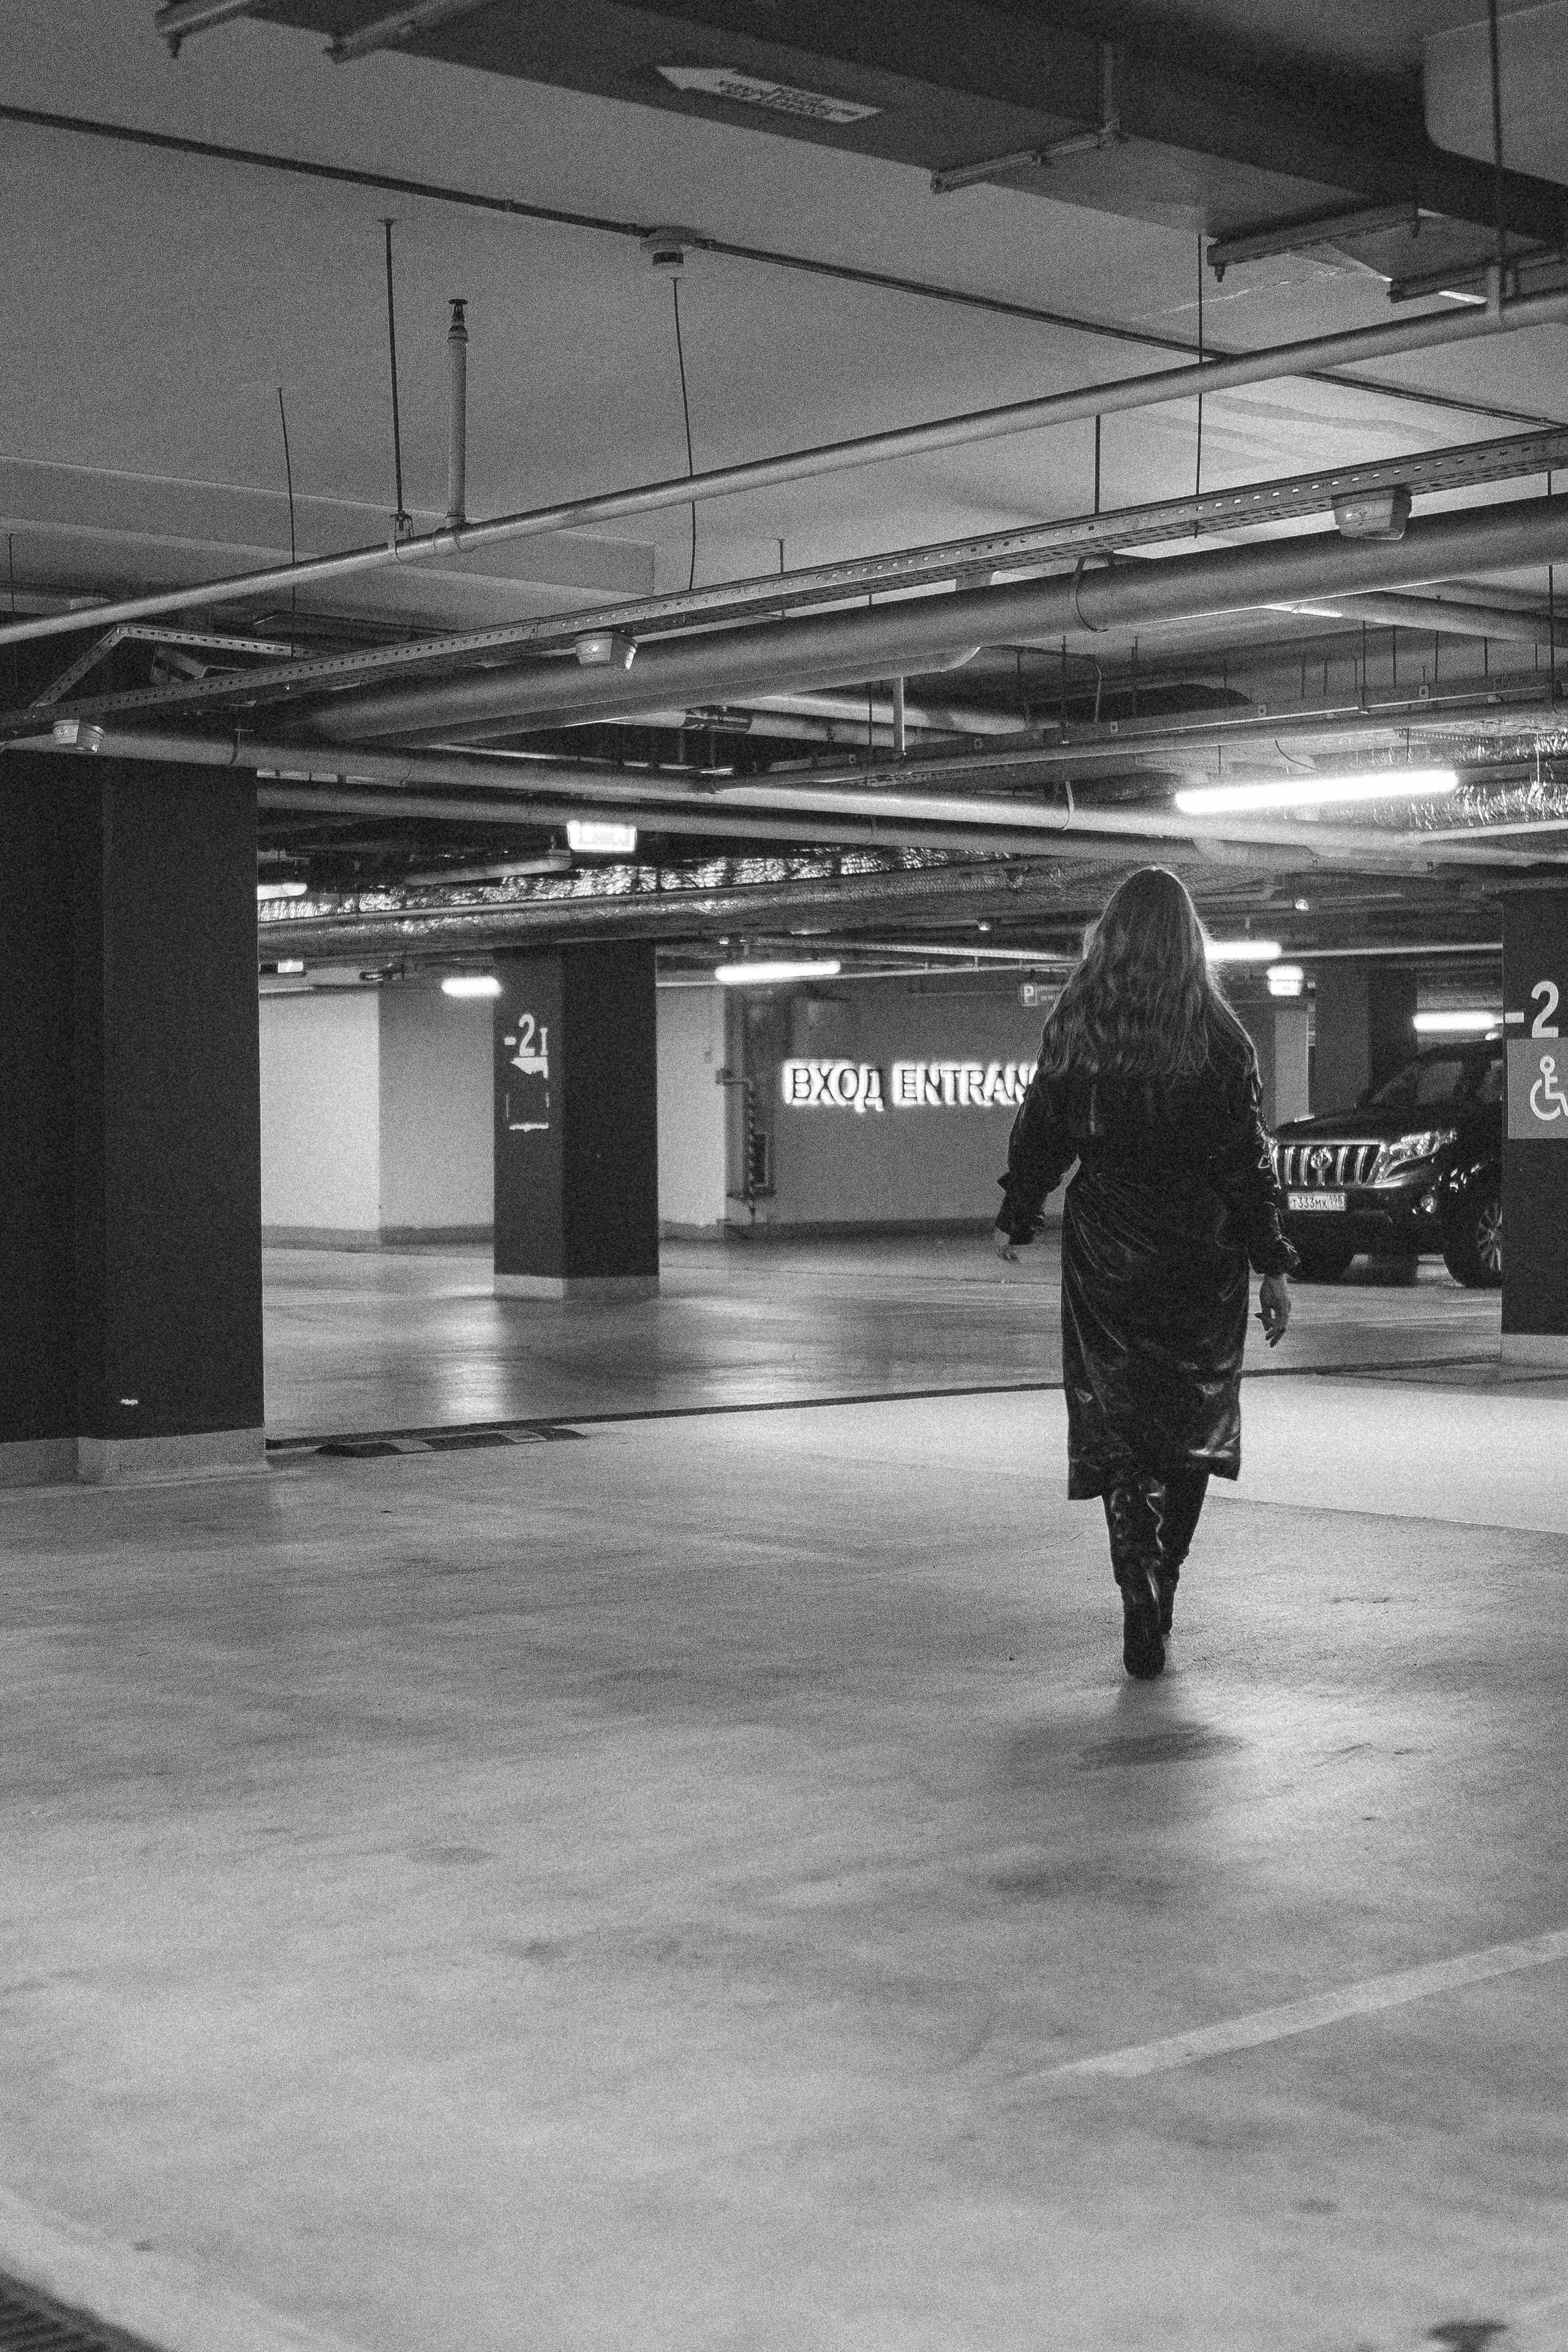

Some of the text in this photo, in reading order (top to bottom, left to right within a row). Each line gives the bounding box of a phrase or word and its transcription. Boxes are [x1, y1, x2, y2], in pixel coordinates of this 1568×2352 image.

[1023, 985, 1034, 1004] P
[1505, 981, 1559, 1038] -2
[785, 1062, 884, 1111] ВХОД
